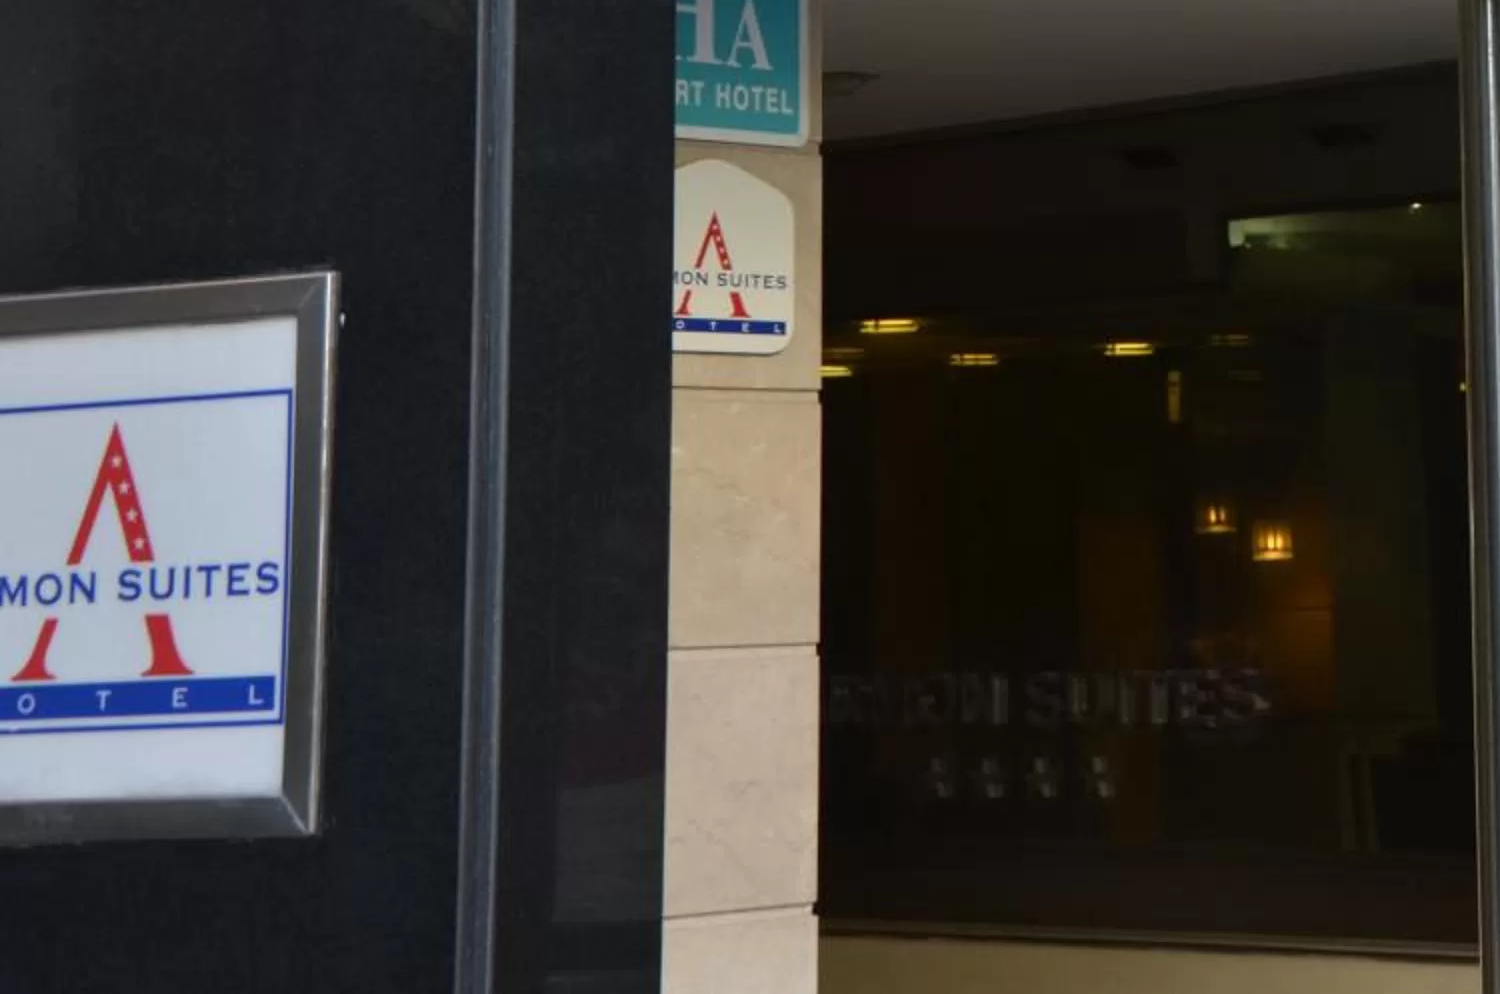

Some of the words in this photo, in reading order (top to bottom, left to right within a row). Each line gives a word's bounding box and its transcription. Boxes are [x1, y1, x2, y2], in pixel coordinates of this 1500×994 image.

[715, 82, 795, 117] HOTEL
[717, 272, 787, 290] SUITES
[0, 571, 97, 607] MON
[117, 561, 280, 602] SUITES
[16, 685, 265, 716] OTEL
